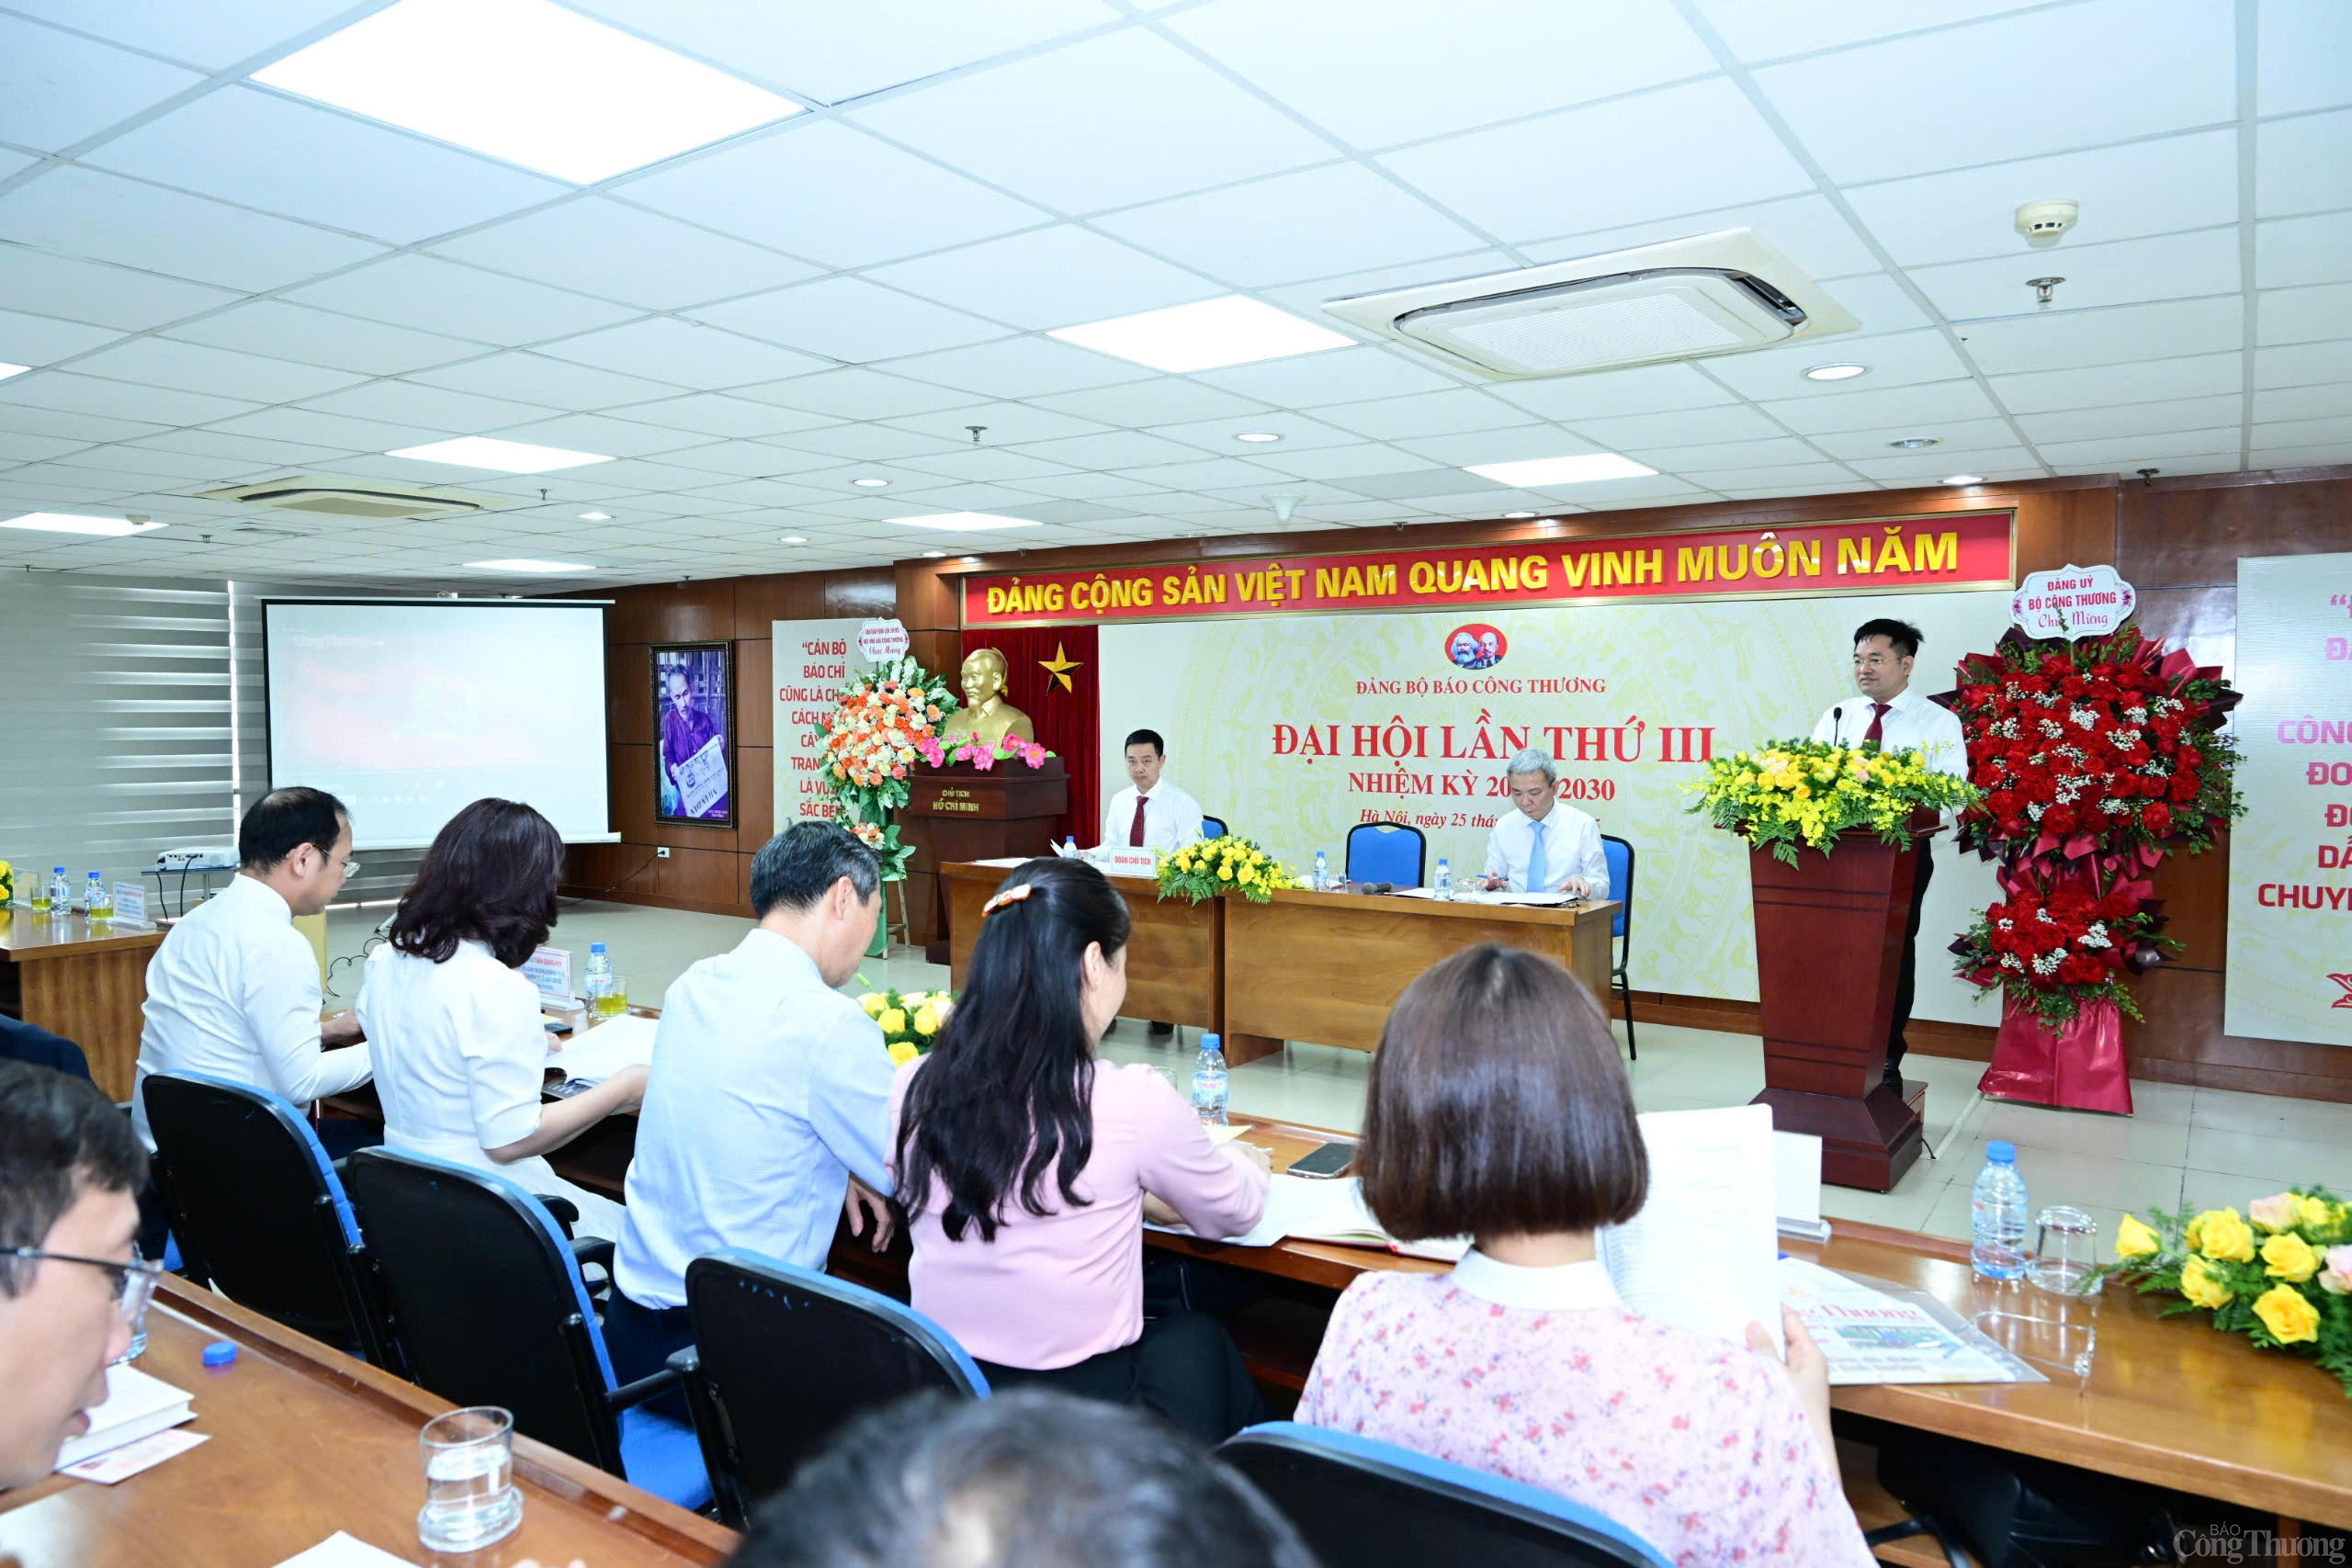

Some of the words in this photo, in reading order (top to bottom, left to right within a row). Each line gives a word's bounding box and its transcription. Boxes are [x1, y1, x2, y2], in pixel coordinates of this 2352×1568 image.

[987, 577, 1065, 614] ĐẢNG
[1070, 574, 1154, 614] CỘNG
[1162, 566, 1227, 605] SẢN
[1234, 563, 1306, 606] VIỆT
[1316, 564, 1397, 598] NAM
[1408, 555, 1549, 594] QUANG
[1562, 548, 1663, 588] VINH
[1678, 532, 1821, 582] MUÔN
[1838, 525, 1959, 574] NĂM
[2047, 578, 2076, 592] ĐẢNG
[2029, 595, 2042, 613] BỘ
[2045, 594, 2073, 609] CÔNG
[2076, 592, 2117, 606] THƯƠNG
[831, 637, 846, 659] BỘ
[2323, 637, 2352, 661] Đ
[804, 661, 825, 678] BÁO
[828, 661, 845, 678] CHÍ
[779, 685, 808, 702] CŨNG
[809, 685, 823, 702] LÀ
[1356, 677, 1401, 694] ĐẢNG
[1406, 676, 1429, 697] BỘ
[1433, 677, 1467, 694] BÁO
[1473, 676, 1521, 694] CÔNG
[1528, 676, 1607, 694] THƯƠNG
[792, 708, 819, 724] CÁCH
[1272, 724, 1340, 764] ĐẠI
[1351, 715, 1429, 767] HỘI
[1441, 708, 1531, 760] LẦN
[1544, 715, 1645, 762] THỨ
[1657, 727, 1715, 762] III
[791, 756, 820, 771] TRAN
[800, 777, 813, 794] LÀ
[1349, 768, 1433, 799] NHIỆM
[1441, 769, 1479, 796] KỲ
[799, 797, 820, 817] SẮC
[959, 802, 979, 812] MINH
[2324, 804, 2352, 827] Đ
[1360, 809, 1379, 824] Hà
[1416, 812, 1447, 829] ngày
[1452, 813, 1467, 827] 25
[2257, 883, 2352, 911] CHUY
